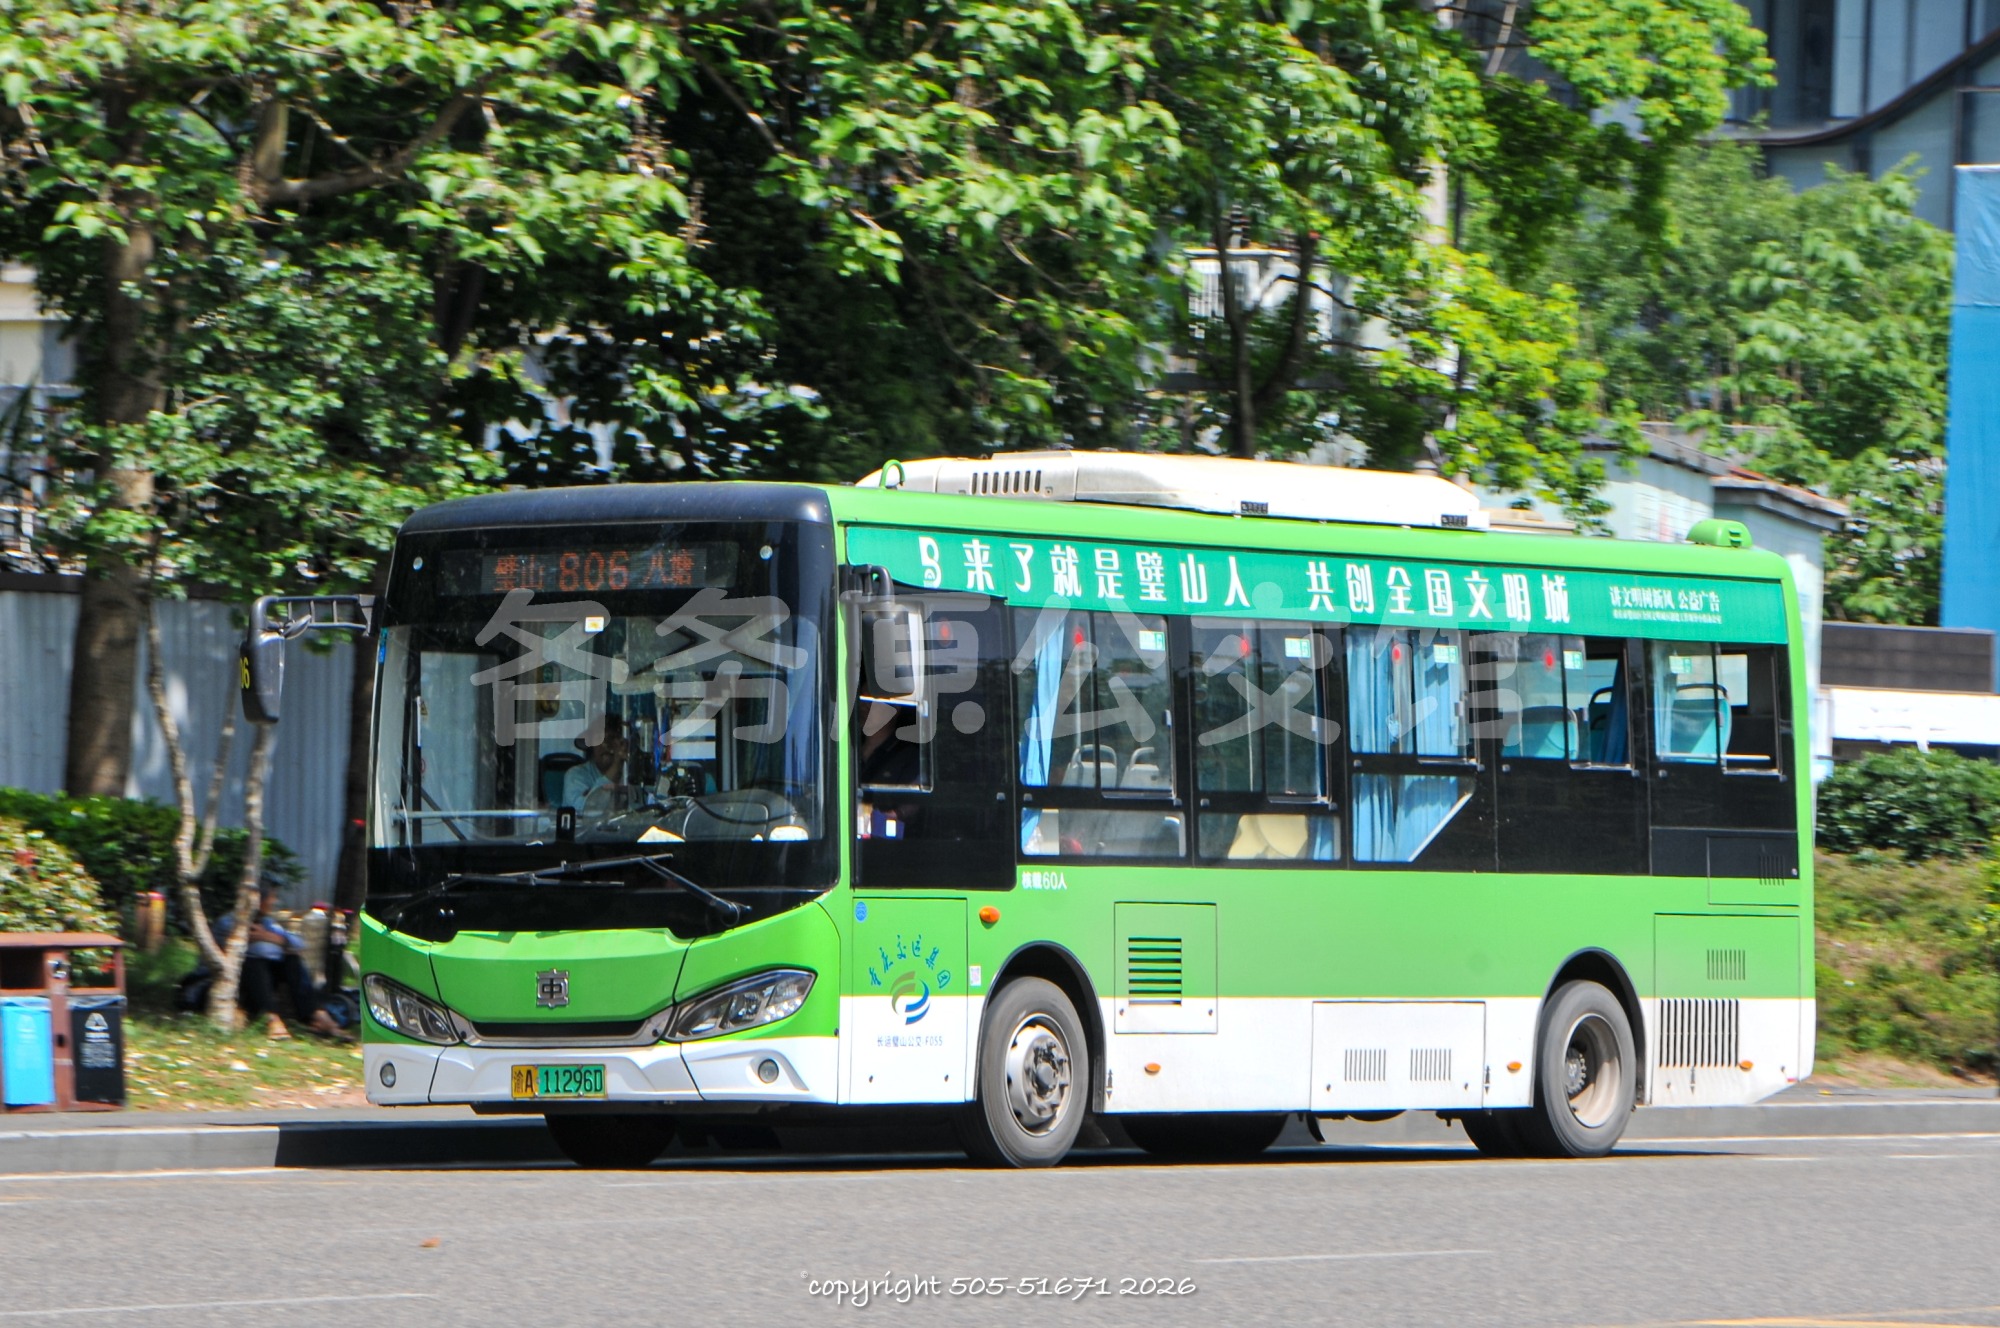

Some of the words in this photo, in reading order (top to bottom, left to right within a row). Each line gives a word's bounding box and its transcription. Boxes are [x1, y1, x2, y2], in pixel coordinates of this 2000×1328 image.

[559, 551, 630, 592] 806
[963, 539, 1251, 607] 来了就是璧山人
[1306, 561, 1571, 624] 共创全国文明城
[1678, 589, 1720, 613] 公益广告
